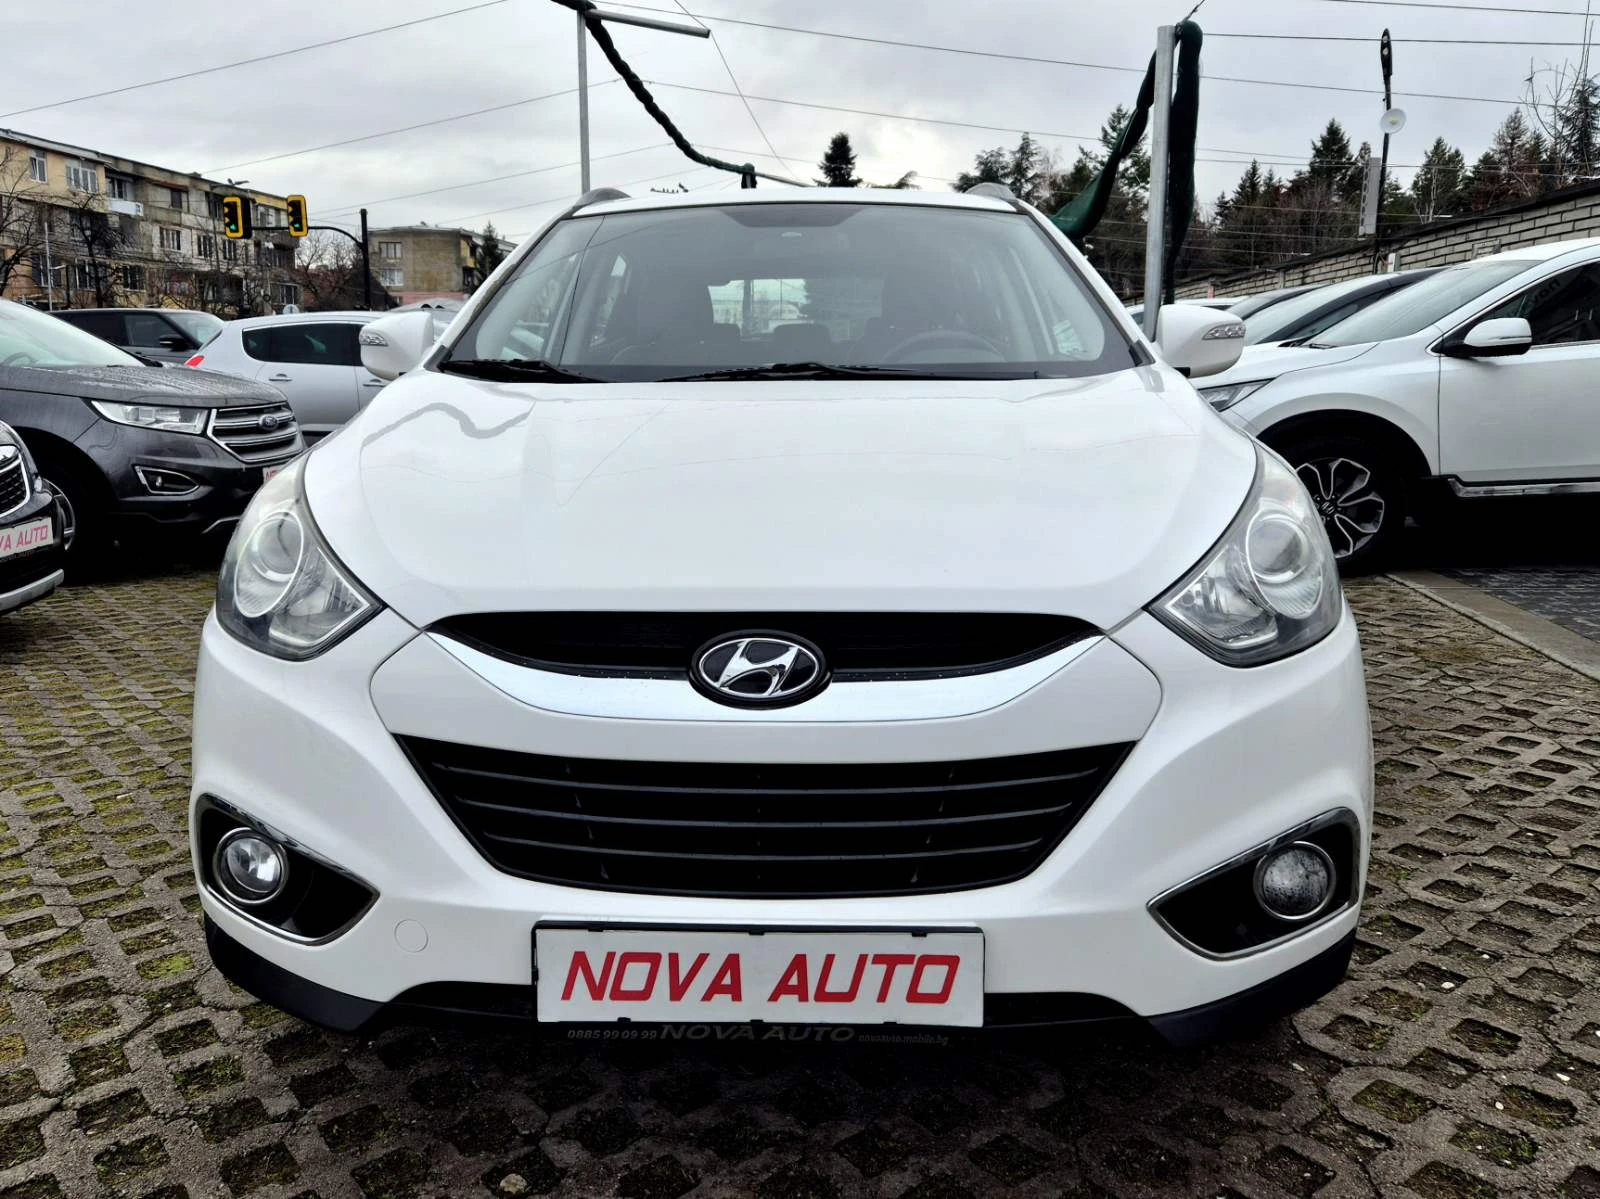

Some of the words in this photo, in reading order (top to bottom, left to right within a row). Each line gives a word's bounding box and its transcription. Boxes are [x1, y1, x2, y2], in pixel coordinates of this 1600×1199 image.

[16, 525, 49, 548] AUTO
[560, 950, 743, 1003] NOVA
[767, 953, 961, 1004] AUTO
[567, 1030, 600, 1040] 0885
[660, 1023, 755, 1041] NOVA
[762, 1025, 855, 1043] AUTO
